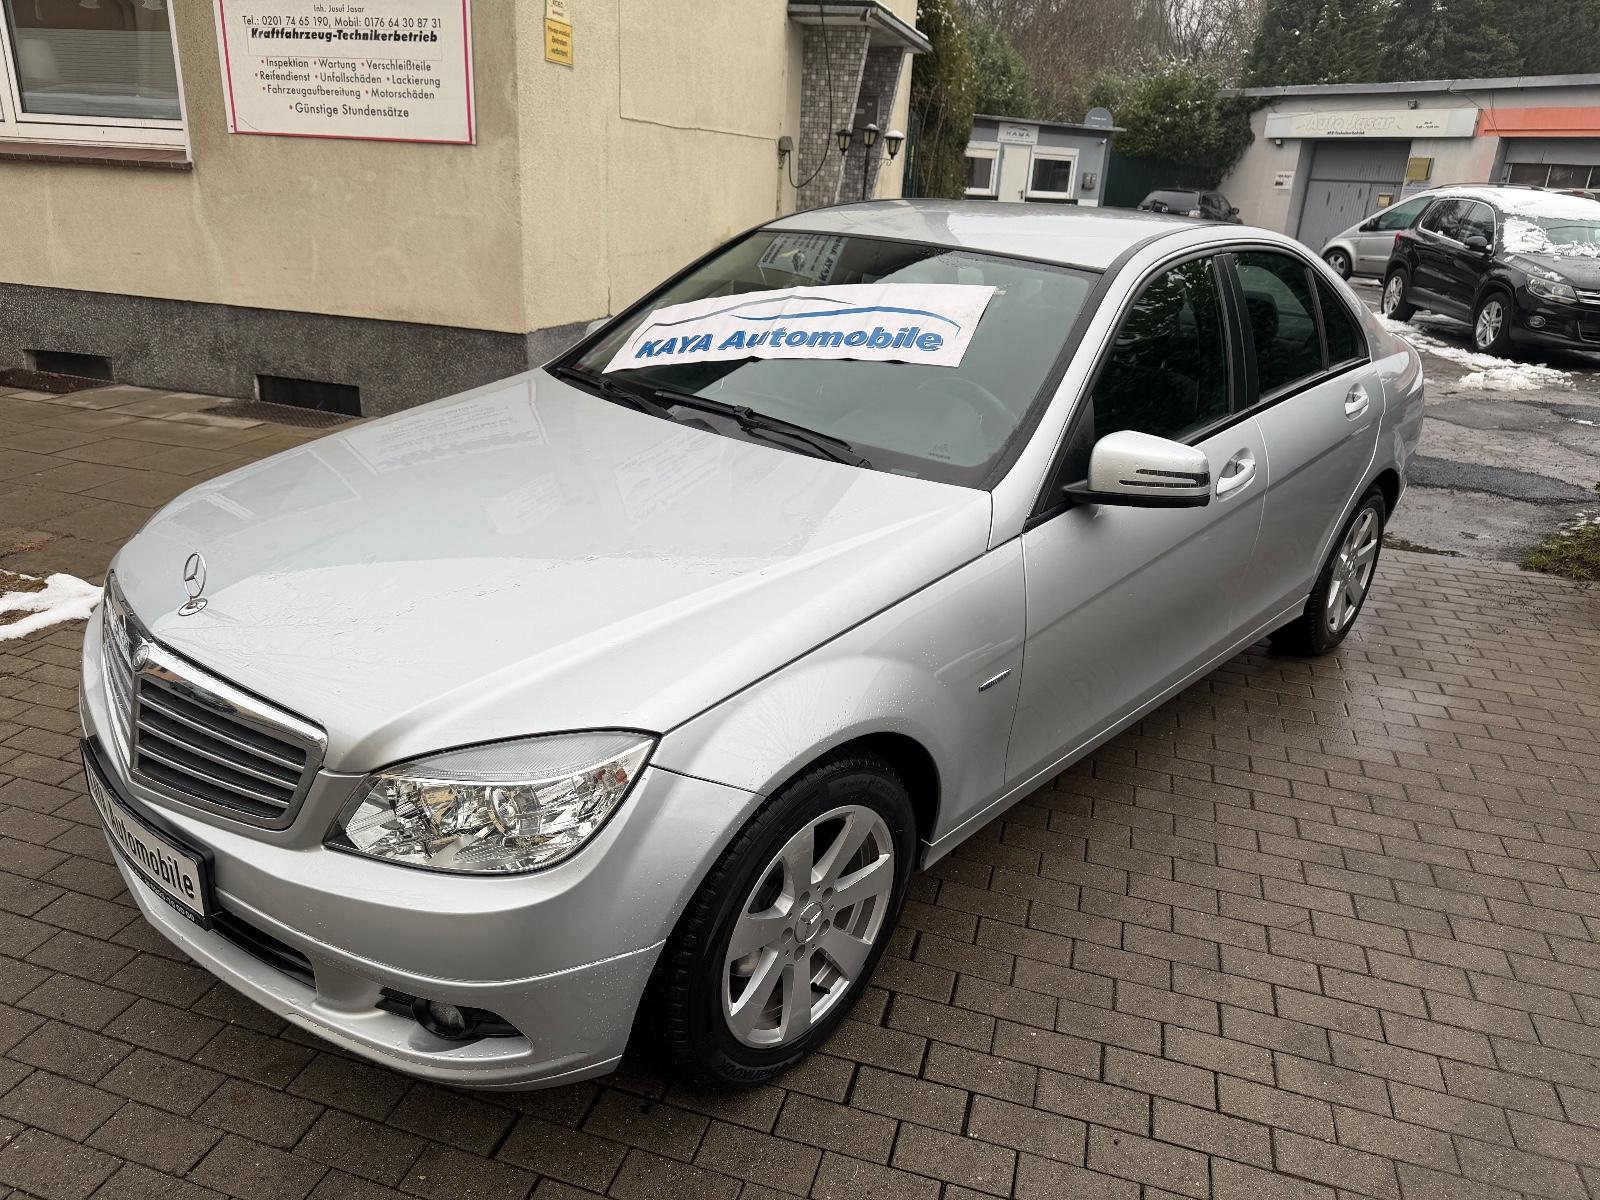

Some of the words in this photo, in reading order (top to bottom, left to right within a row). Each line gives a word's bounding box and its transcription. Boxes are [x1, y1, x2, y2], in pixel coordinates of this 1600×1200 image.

[328, 4, 345, 13] Jusuf
[347, 4, 365, 13] Jasar
[242, 15, 259, 25] Tel.:
[261, 16, 282, 26] 0201
[285, 16, 297, 26] 74
[299, 16, 310, 26] 65
[313, 16, 332, 28] 190,
[334, 17, 362, 27] Mobil:
[364, 17, 385, 28] 0176
[388, 17, 399, 28] 64
[402, 18, 414, 28] 30
[417, 18, 428, 28] 87
[431, 18, 442, 28] 31
[251, 27, 438, 43] Kraftfahrzeug-Technikerbetrieb
[266, 58, 309, 69] Inspektion
[317, 59, 357, 71] Wartung
[366, 60, 432, 72] Verschleißteile
[259, 71, 311, 82] Reifendienst
[320, 72, 382, 84] Unfallschäden
[392, 75, 441, 88] Lackierung
[267, 85, 361, 99] Fahrzeugaufbereitung
[371, 89, 435, 100] Motorschäden
[295, 102, 339, 117] Günstige
[342, 104, 410, 118] Stundensätze
[635, 332, 715, 360] KAYA
[718, 325, 944, 353] Automobile
